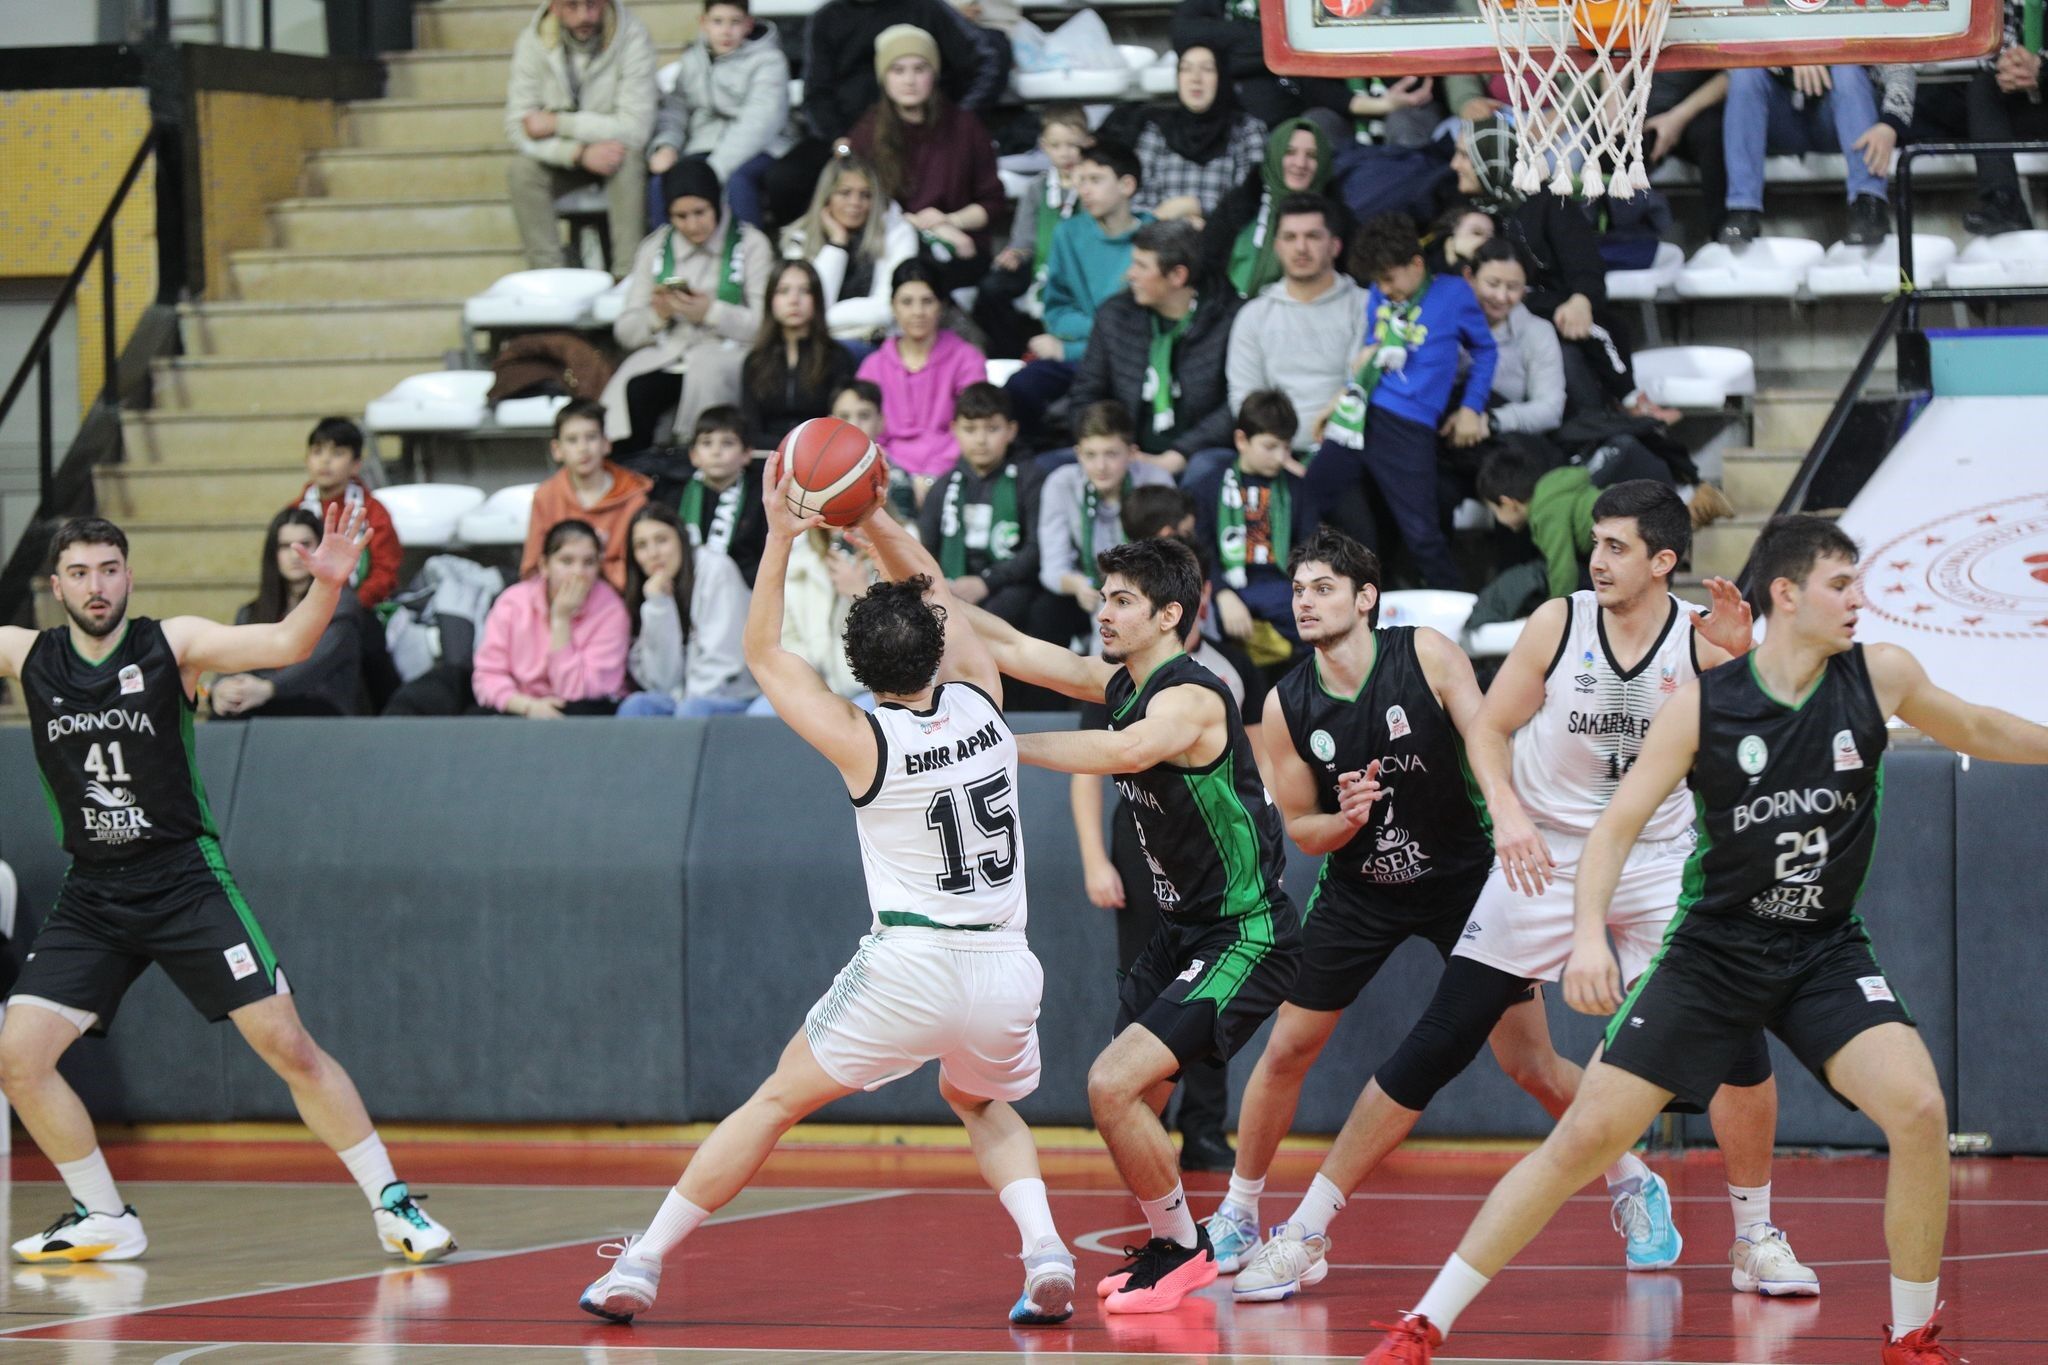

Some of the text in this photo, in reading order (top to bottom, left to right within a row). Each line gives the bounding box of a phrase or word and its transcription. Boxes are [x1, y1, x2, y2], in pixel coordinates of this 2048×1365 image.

[47, 708, 156, 742] BORNOVA
[956, 720, 1003, 762] APAK
[1568, 710, 1636, 738] SAKARYA
[83, 740, 132, 782] 41
[81, 806, 152, 830] ESER
[925, 766, 1018, 896] 15
[1373, 864, 1421, 882] HOTELS
